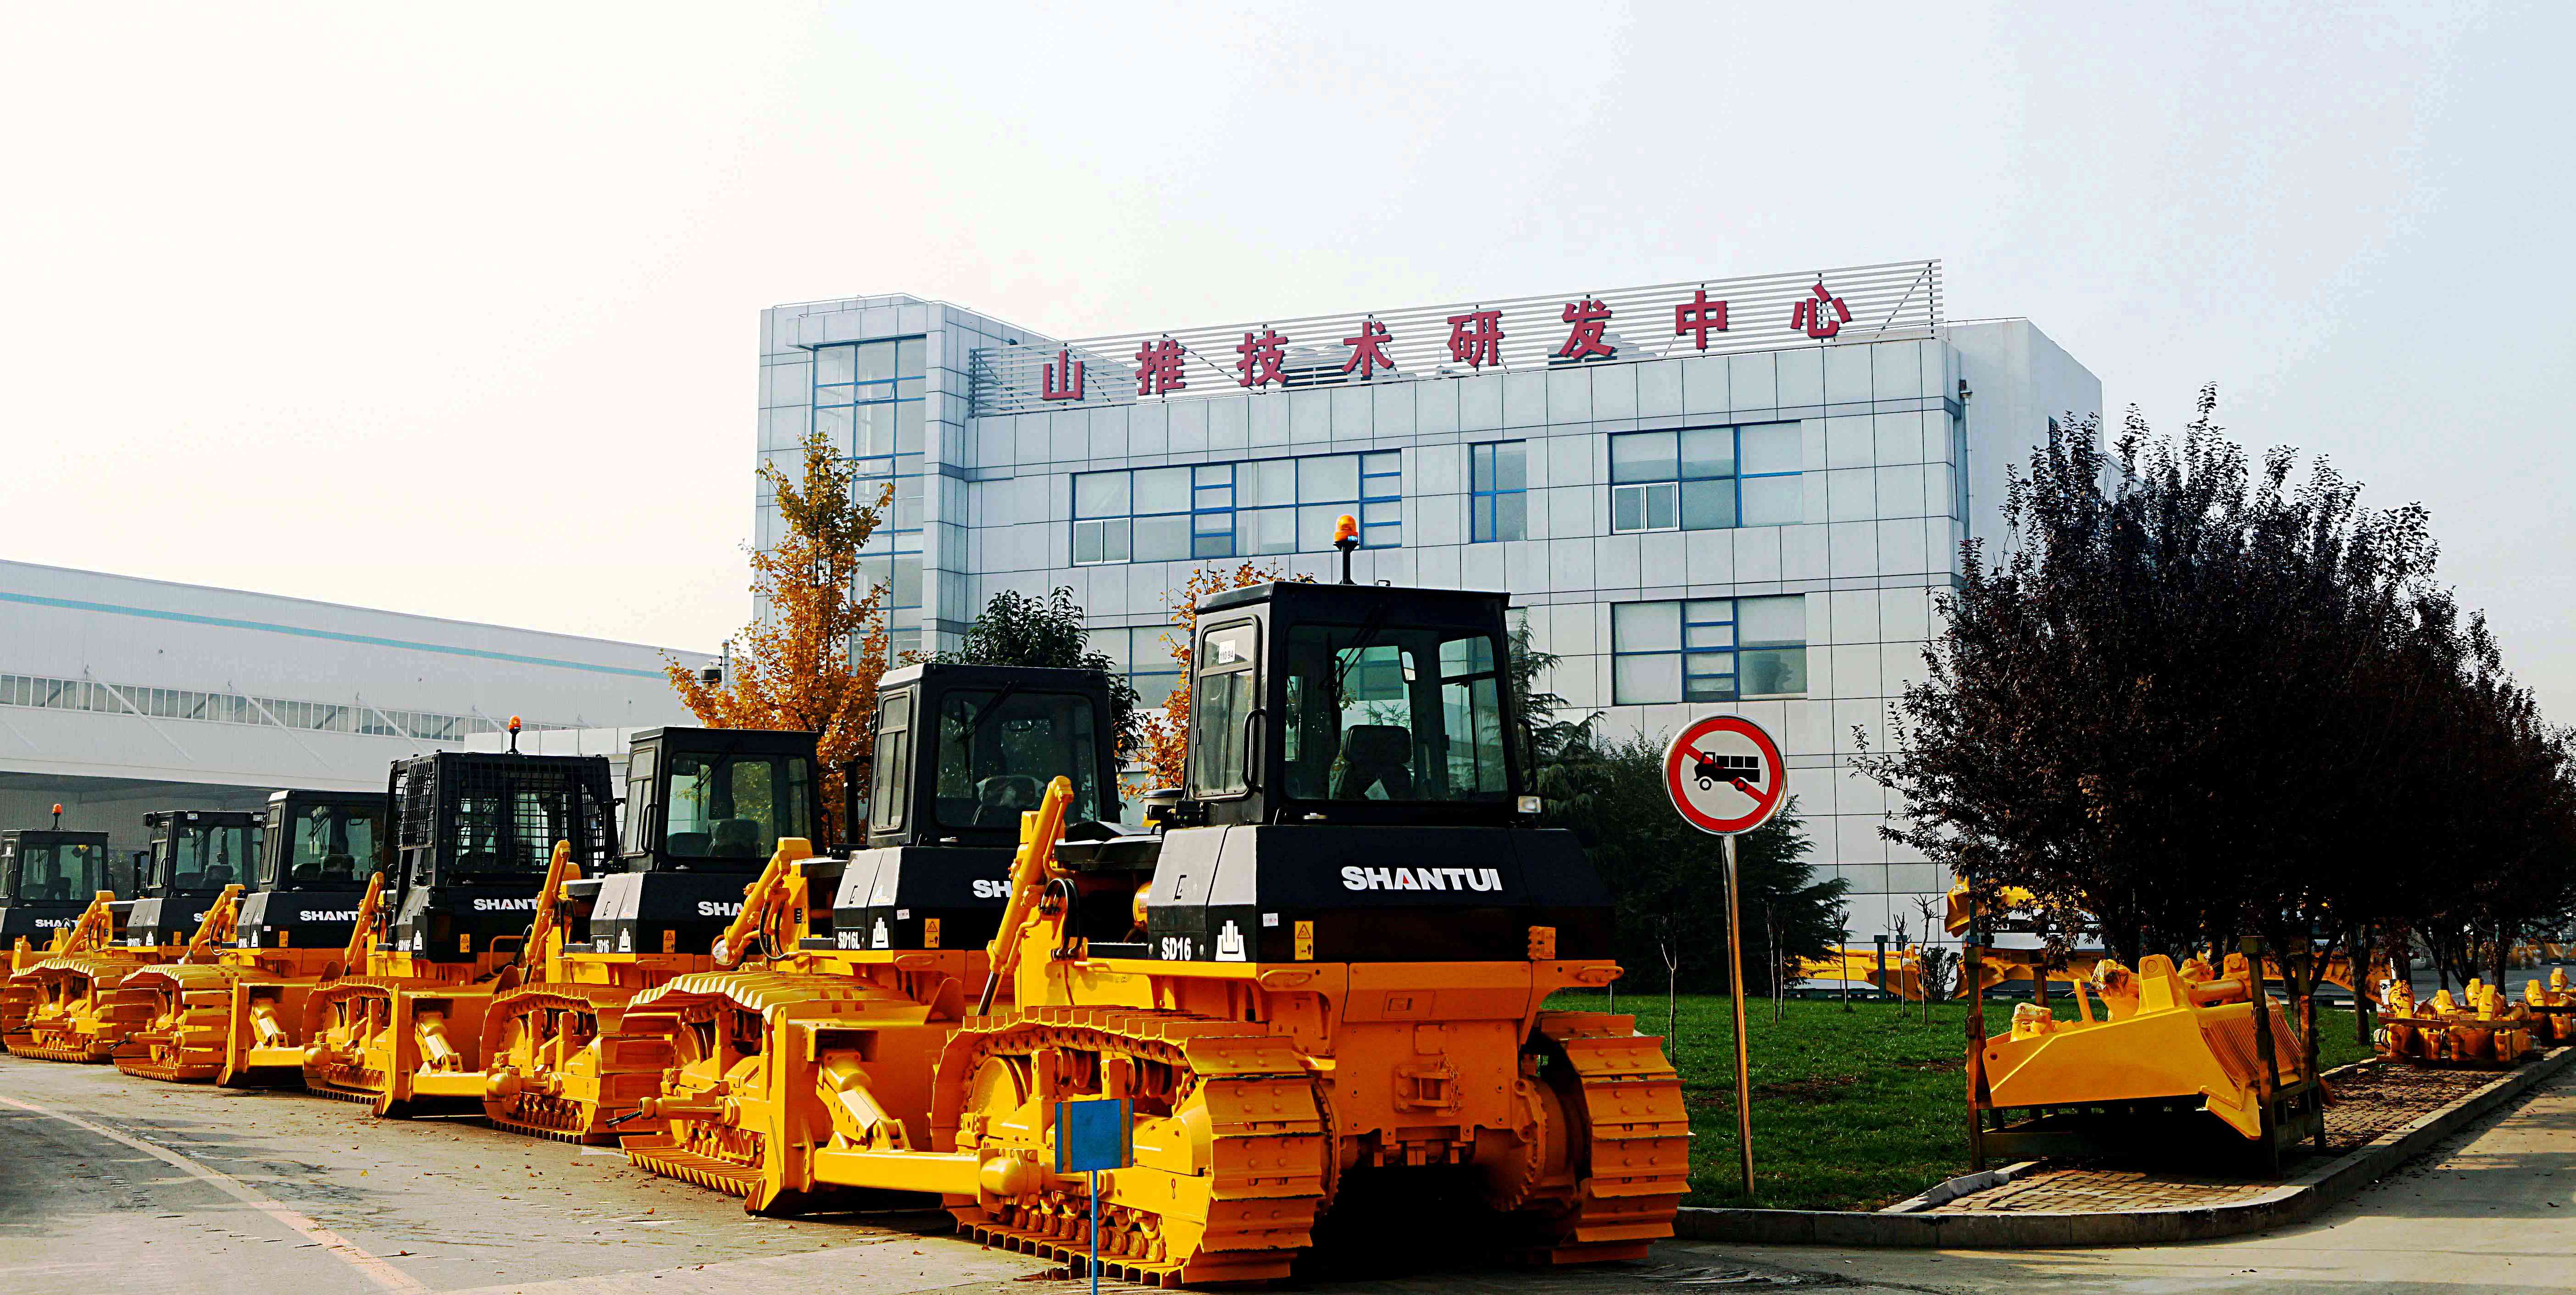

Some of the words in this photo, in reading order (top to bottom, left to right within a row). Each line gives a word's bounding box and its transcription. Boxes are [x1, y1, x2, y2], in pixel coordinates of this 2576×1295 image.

[1042, 283, 1850, 402] 山推技术研发中心
[1341, 866, 1503, 891] SHANTUI
[972, 880, 1013, 898] SH
[473, 899, 537, 910] SHANT
[698, 901, 744, 916] SHA
[300, 910, 358, 921] SHANT
[596, 939, 610, 953] SD16
[838, 931, 861, 949] SD16L
[1161, 937, 1191, 961] SD16
